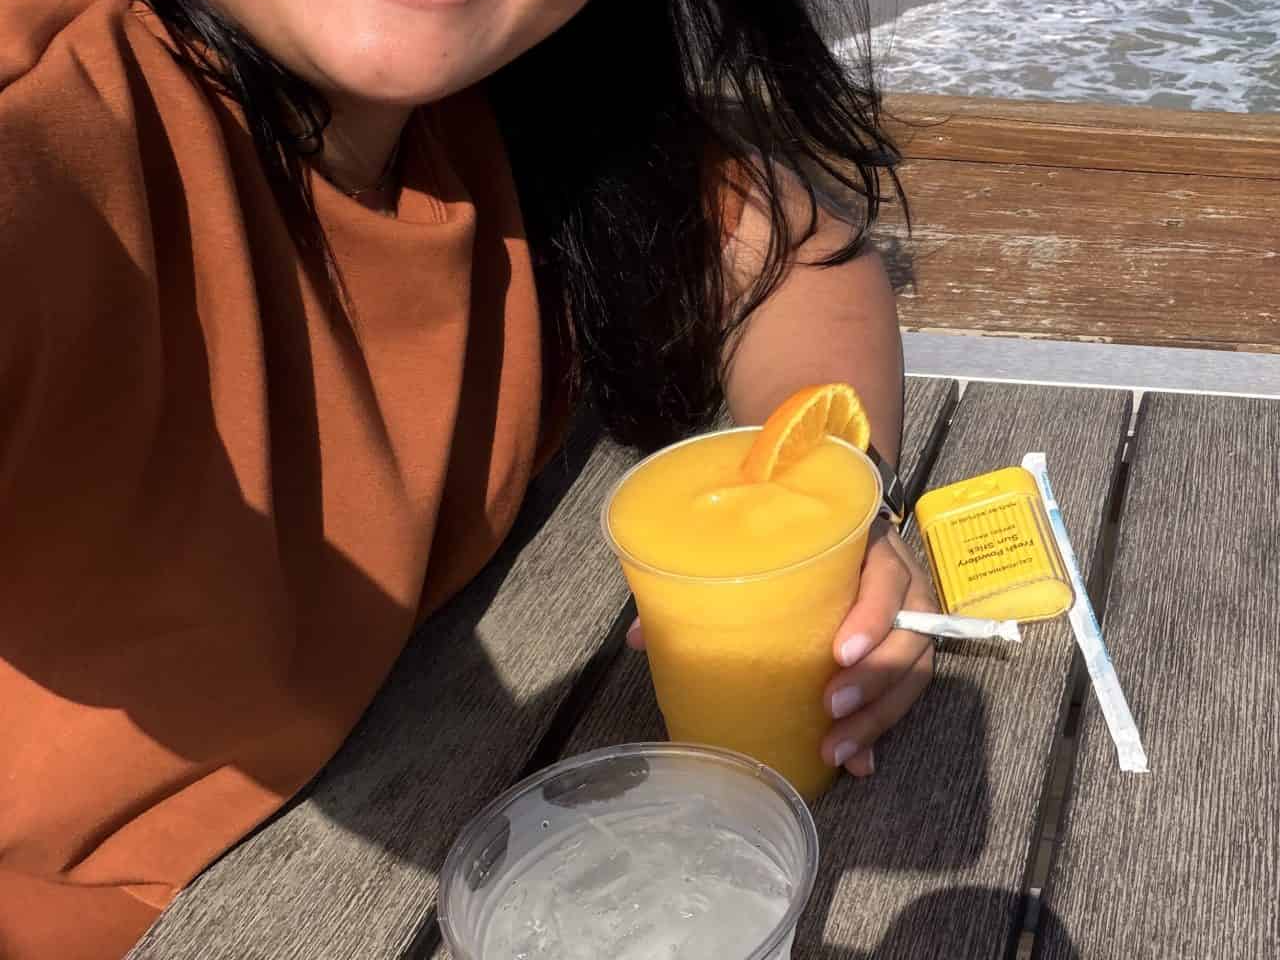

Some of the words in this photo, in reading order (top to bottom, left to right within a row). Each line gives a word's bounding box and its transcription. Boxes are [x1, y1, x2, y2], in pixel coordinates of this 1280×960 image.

[997, 534, 1019, 545] Sun
[1006, 539, 1034, 553] Fresh
[968, 542, 995, 555] Stick
[958, 549, 1004, 568] Powdery
